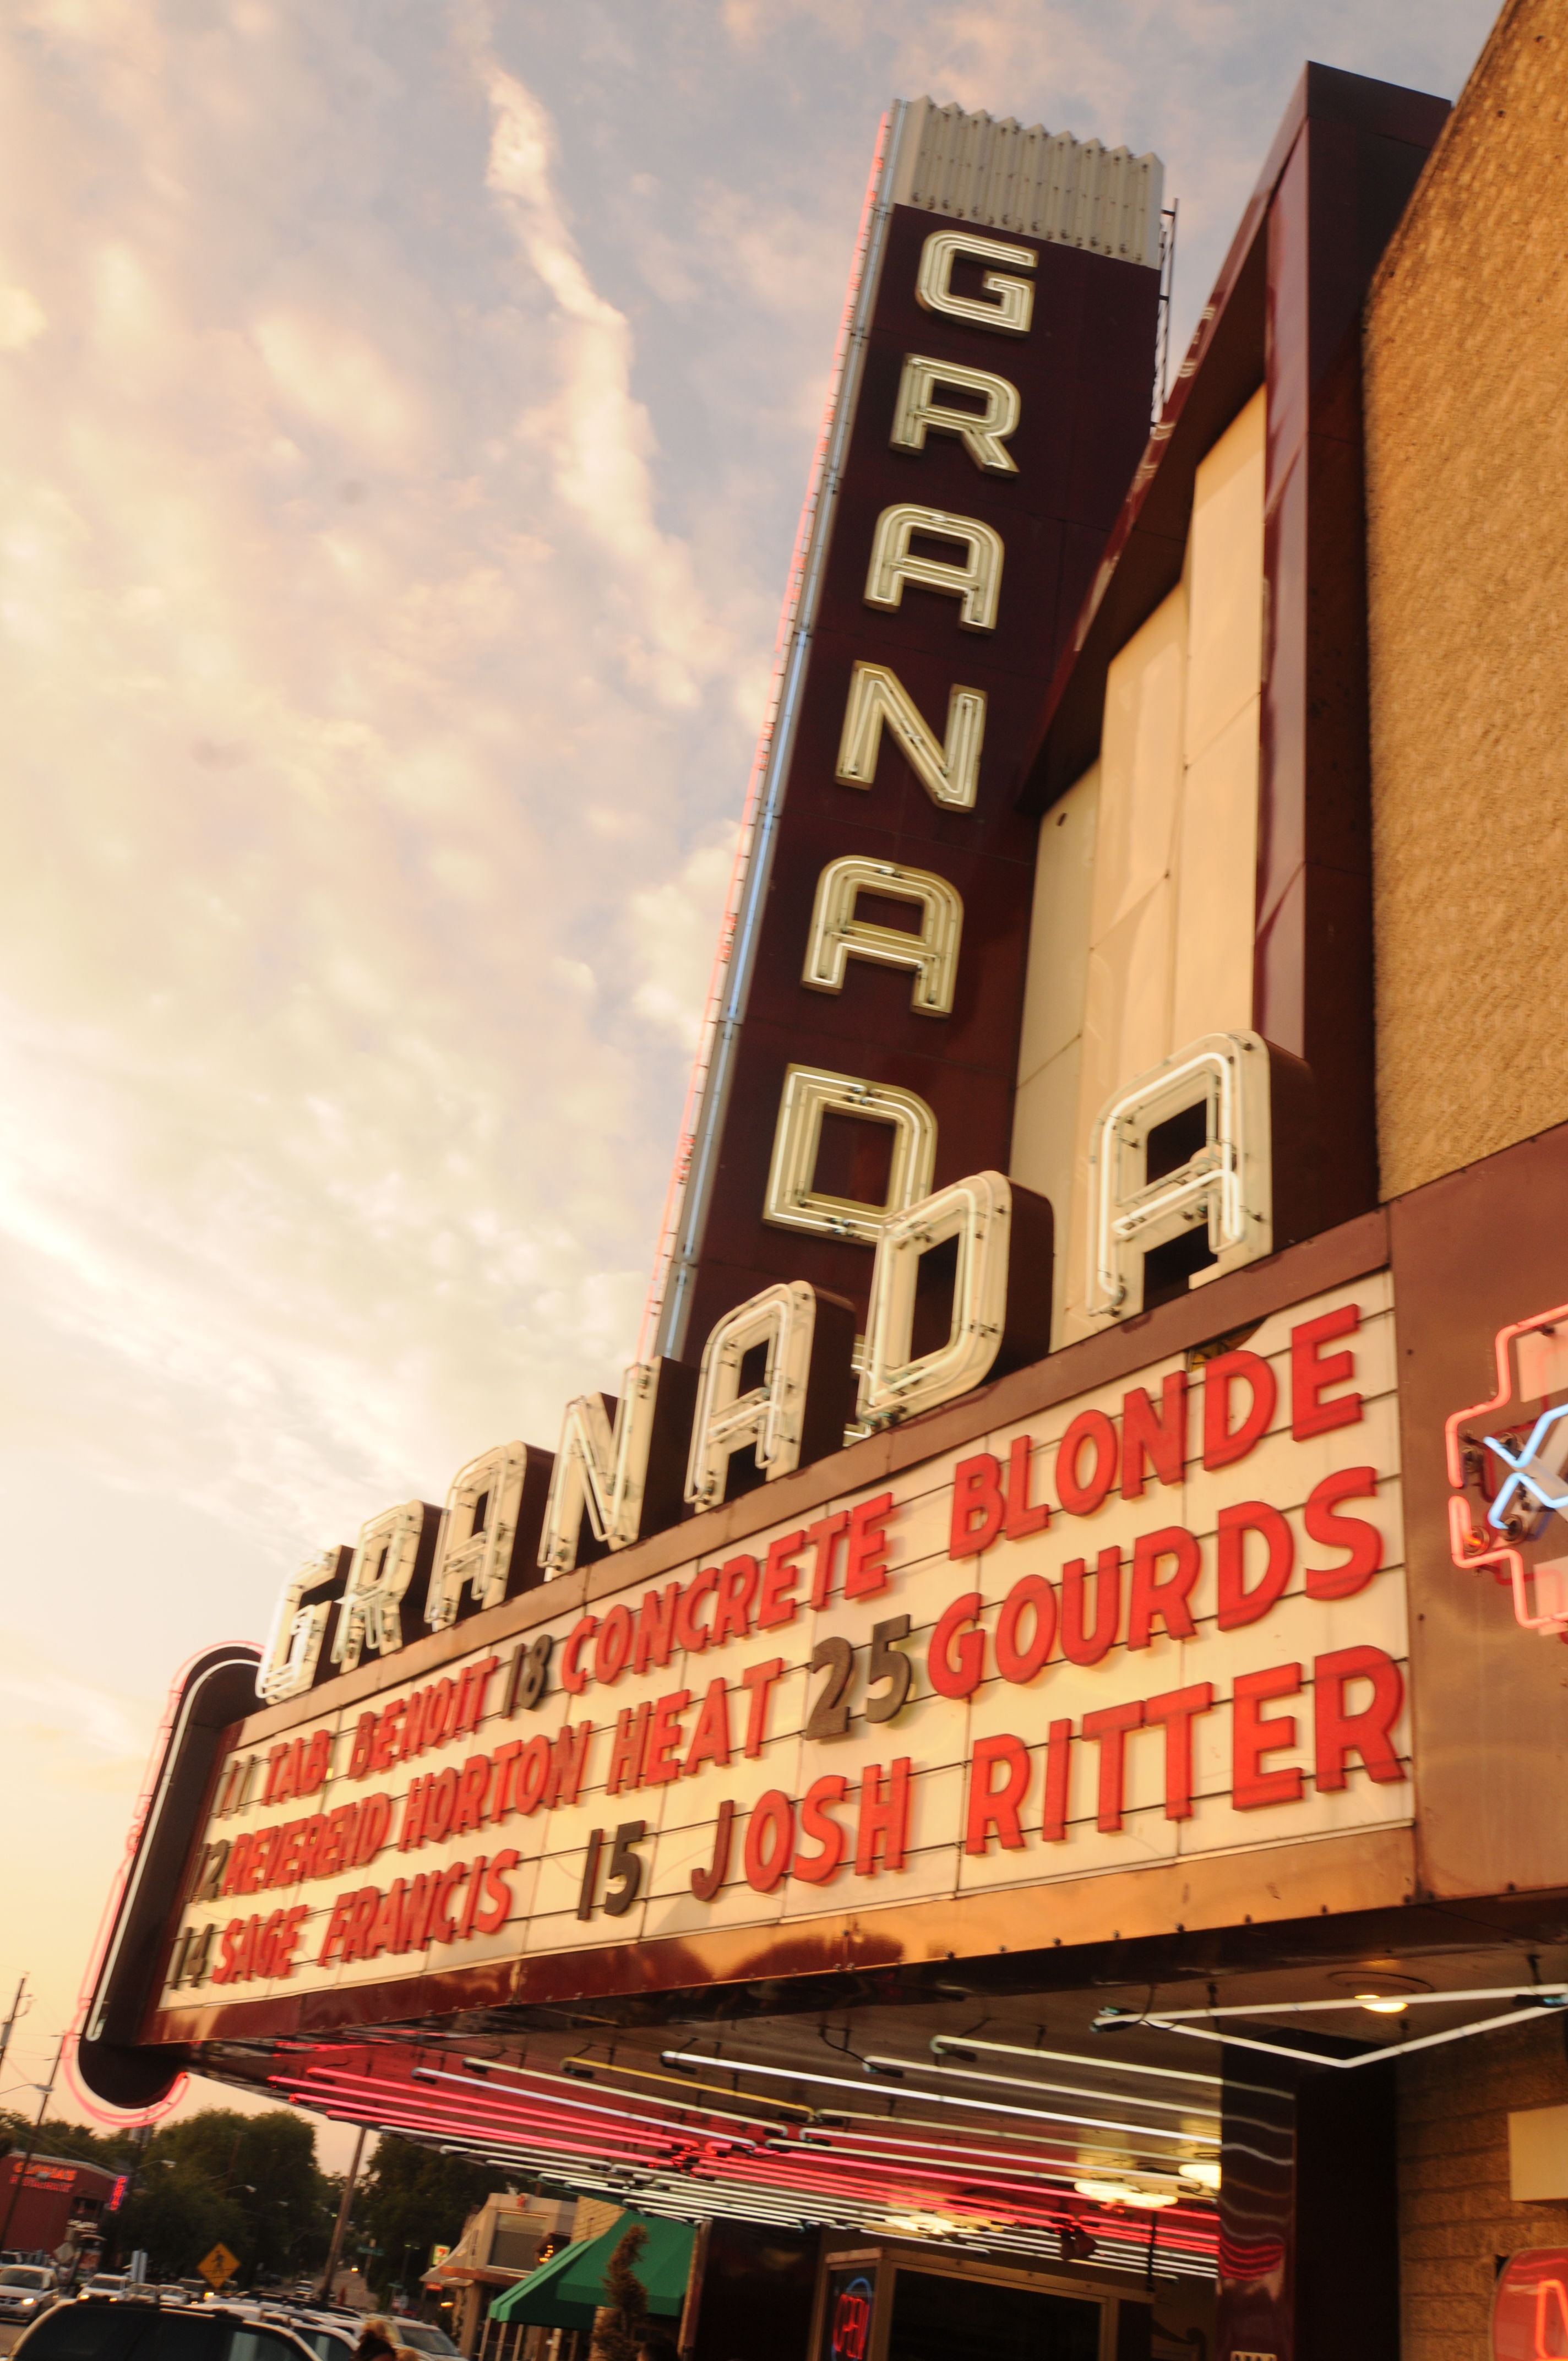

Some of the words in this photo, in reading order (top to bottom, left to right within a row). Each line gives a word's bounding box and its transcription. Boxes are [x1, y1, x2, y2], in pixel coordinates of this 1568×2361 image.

[762, 229, 1039, 1446] GRANAD
[255, 1028, 1273, 1705] GRANADA
[262, 1729, 331, 1808] TAB
[347, 1656, 498, 1780] BENOIT
[501, 1634, 553, 1720] 18
[561, 1492, 894, 1695] CONCRETE
[949, 1303, 1363, 1560] BLONDE
[170, 1923, 215, 1990] 14
[211, 1904, 308, 1984] SAGE
[318, 1849, 520, 1967] FRANCIS
[577, 1820, 646, 1921] 15
[690, 1756, 911, 1905] JOSH
[965, 1645, 1407, 1856] RITTER
[187, 1840, 229, 1903] 12
[221, 1792, 393, 1896] REVEREND
[399, 1720, 591, 1852] HORTON
[607, 1657, 784, 1796] HEAT
[805, 1613, 911, 1741] 25
[927, 1466, 1384, 1700] GOURDS
